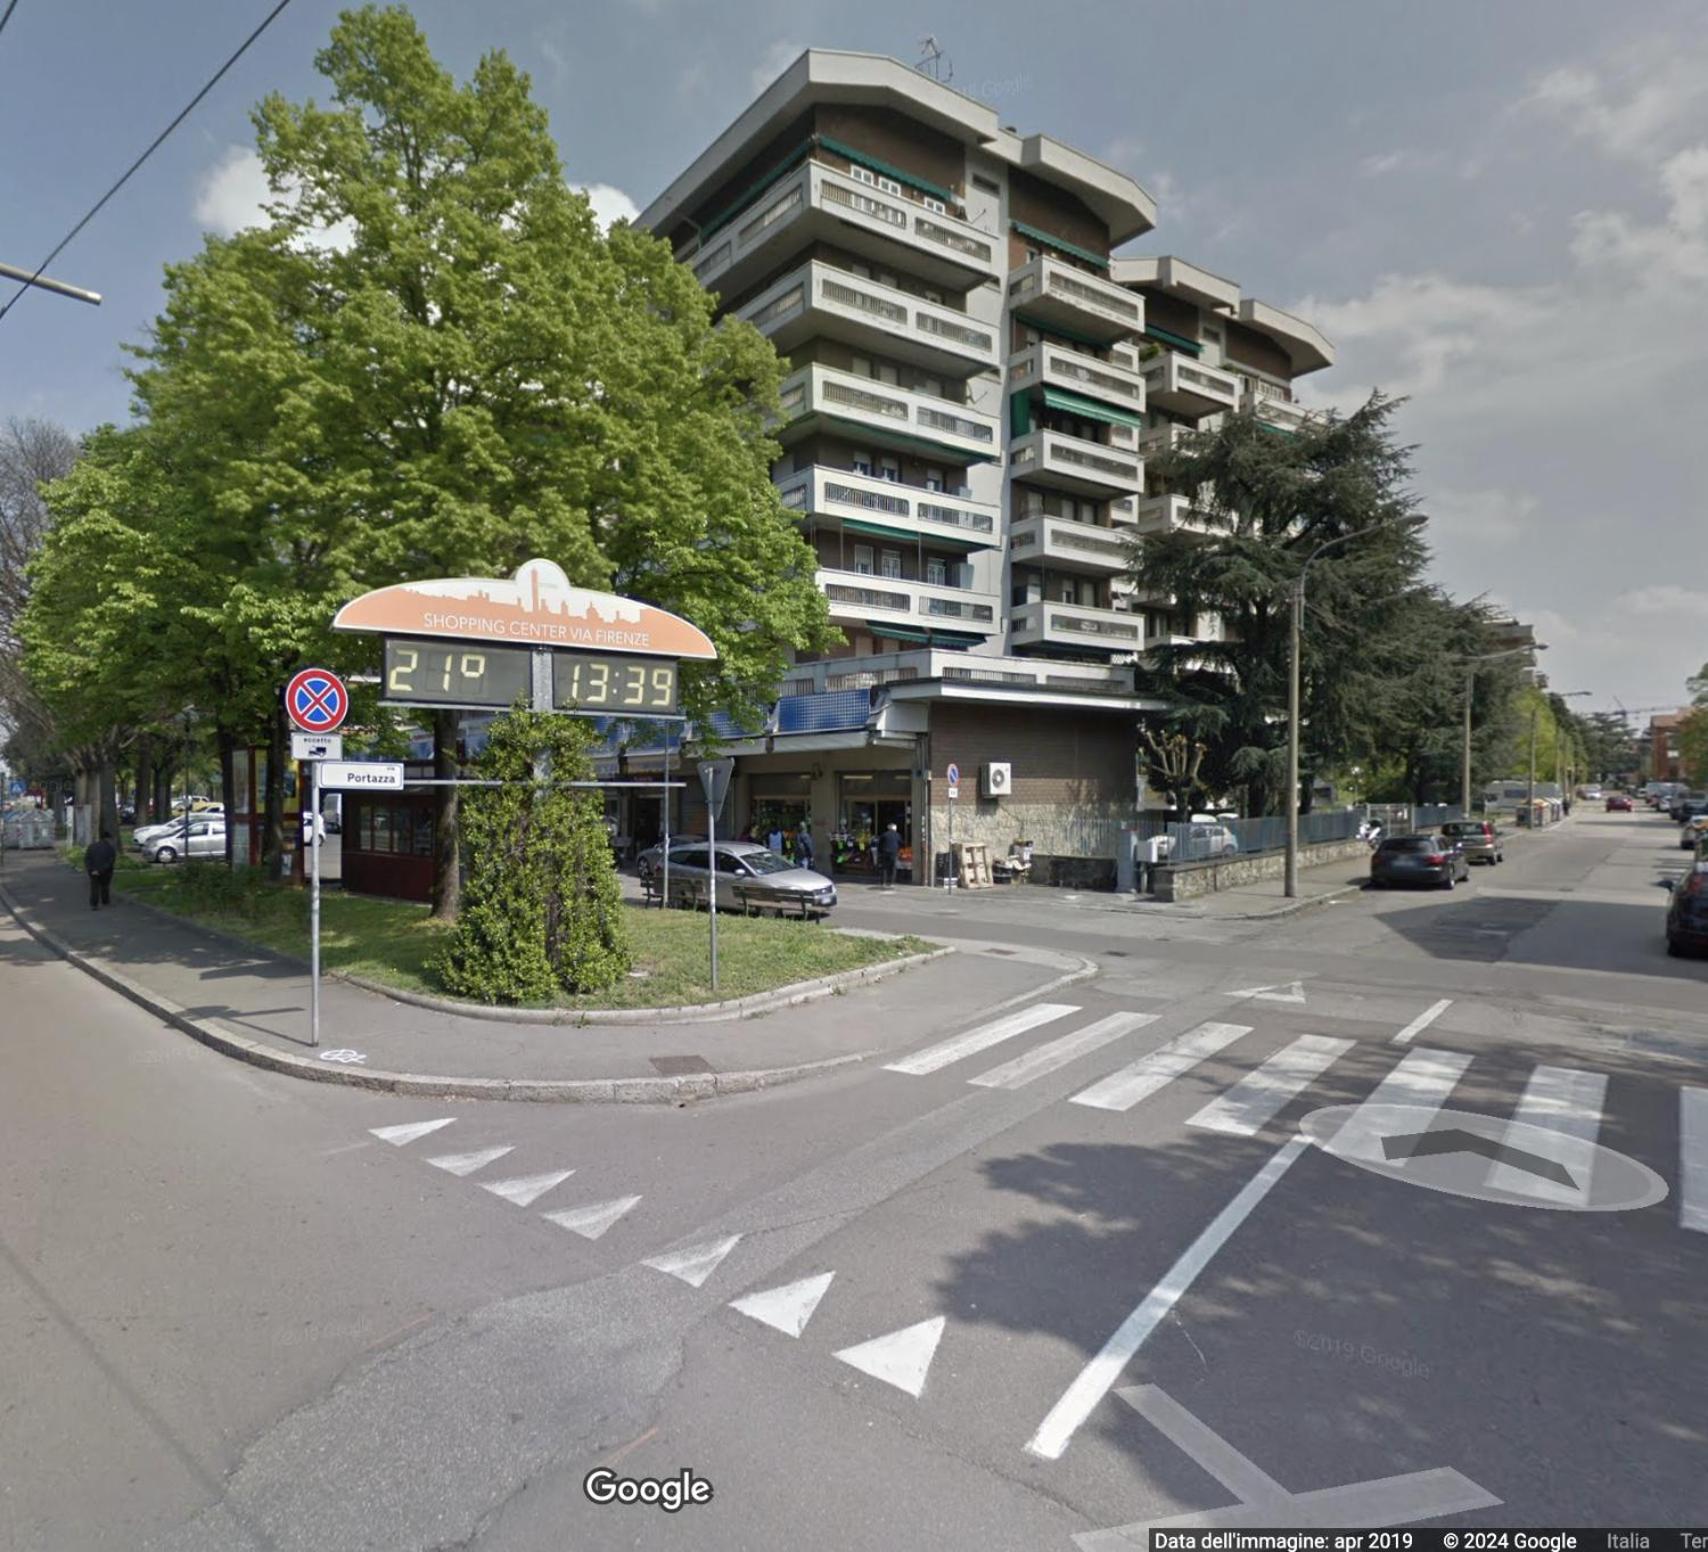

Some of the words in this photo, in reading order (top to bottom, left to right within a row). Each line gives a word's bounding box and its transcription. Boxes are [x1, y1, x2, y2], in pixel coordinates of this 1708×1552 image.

[423, 612, 505, 635] SHOPPING
[509, 620, 567, 640] CENTER
[570, 626, 593, 642] VIA
[595, 629, 649, 646] FIRENZE
[571, 663, 673, 707] 13:39
[347, 772, 396, 784] Portazza
